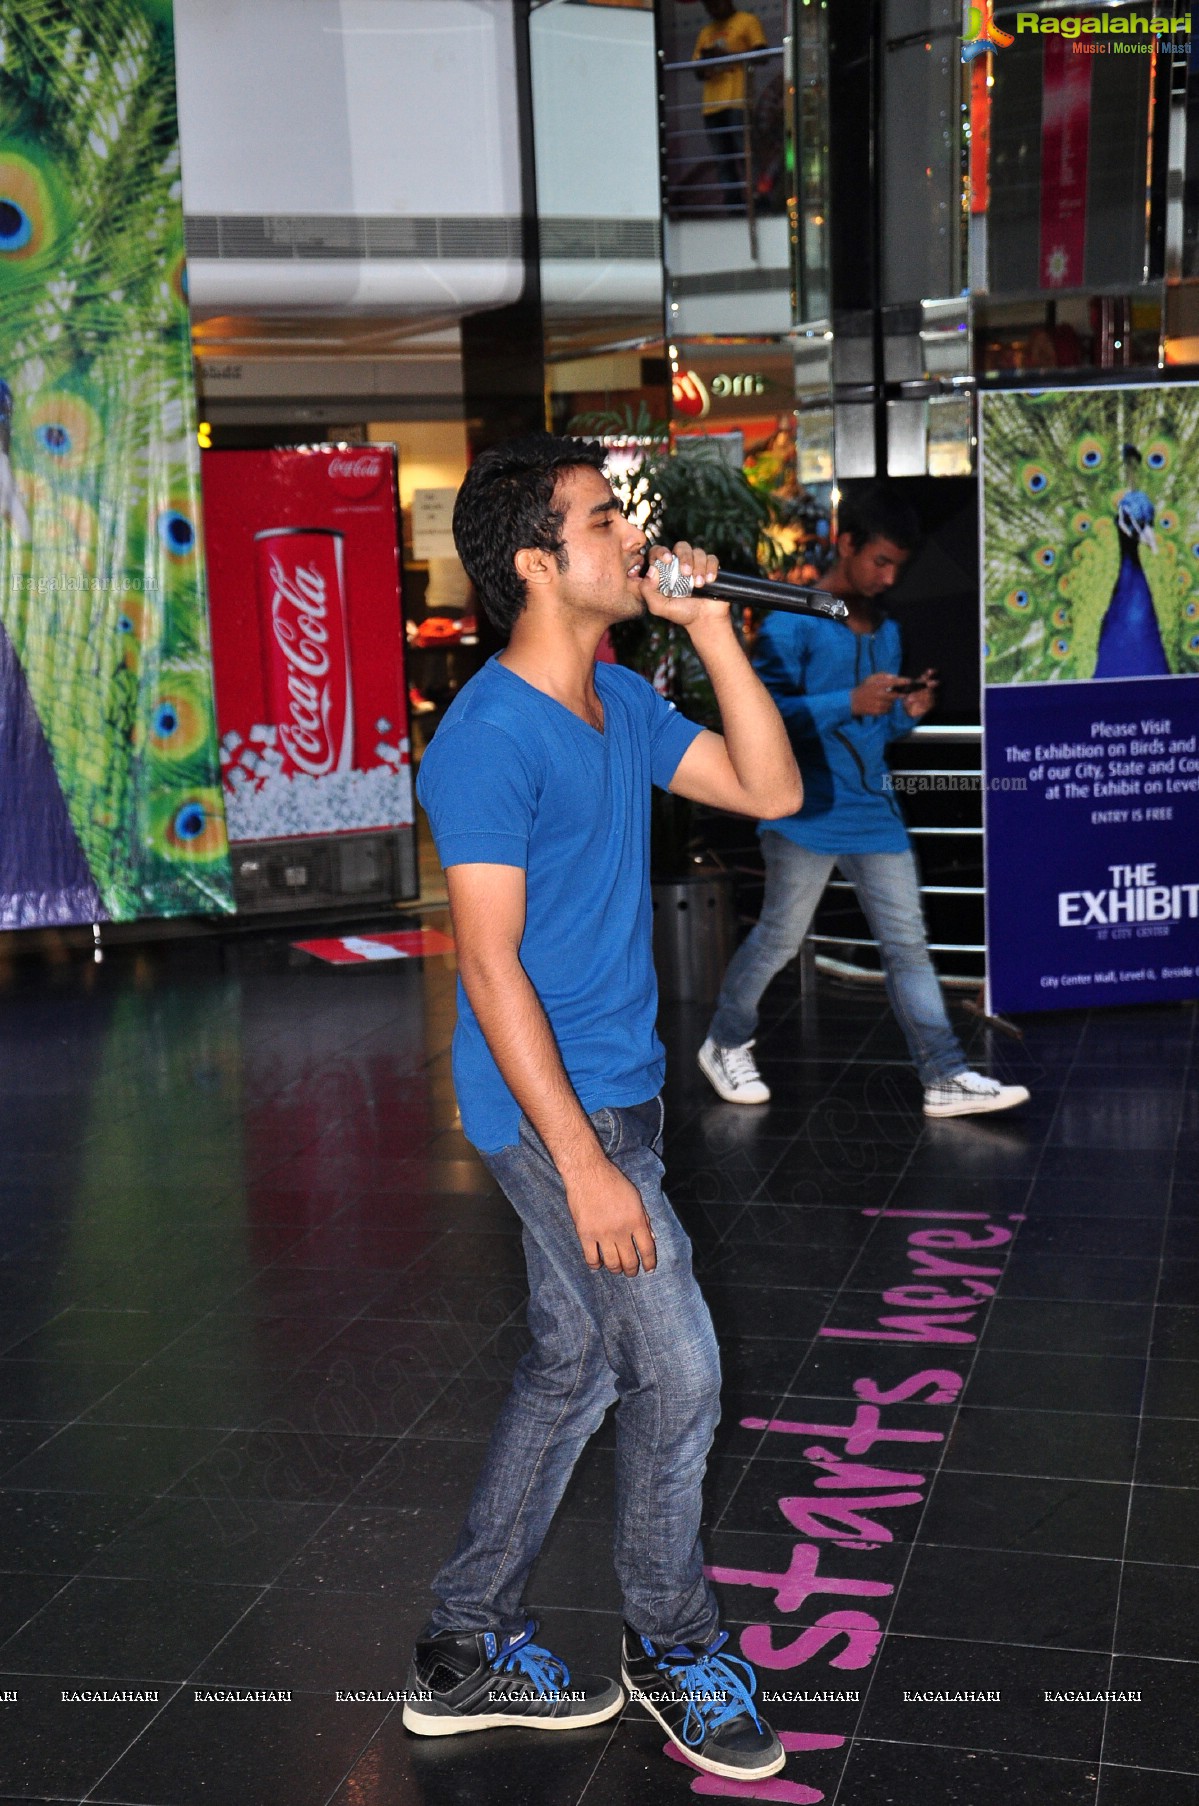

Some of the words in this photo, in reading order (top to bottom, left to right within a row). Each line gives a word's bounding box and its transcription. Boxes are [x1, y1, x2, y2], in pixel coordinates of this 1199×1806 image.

[1090, 721, 1137, 738] Please
[1140, 719, 1171, 735] Visit
[1005, 746, 1031, 762] The
[1034, 743, 1104, 761] Exhibition
[1107, 743, 1126, 757] on
[1130, 738, 1165, 755] Birds
[1168, 736, 1196, 753] and
[1029, 765, 1044, 781] of
[1047, 765, 1071, 780] our
[1108, 761, 1144, 777] State
[1148, 757, 1175, 774] and
[1045, 784, 1060, 800] at
[1064, 781, 1090, 798] The
[1093, 778, 1140, 797] Exhibit
[1144, 780, 1163, 794] on
[1091, 811, 1128, 824] ENTRY
[1131, 808, 1143, 822] IS
[1146, 806, 1173, 820] FREE
[1108, 863, 1157, 888] THE
[1058, 884, 1199, 927] EXHIBIT
[1040, 975, 1059, 988] City
[1060, 973, 1092, 986] Center
[1119, 968, 1145, 981] Level
[819, 1210, 1027, 1344] here!
[706, 1369, 963, 1671] starts
